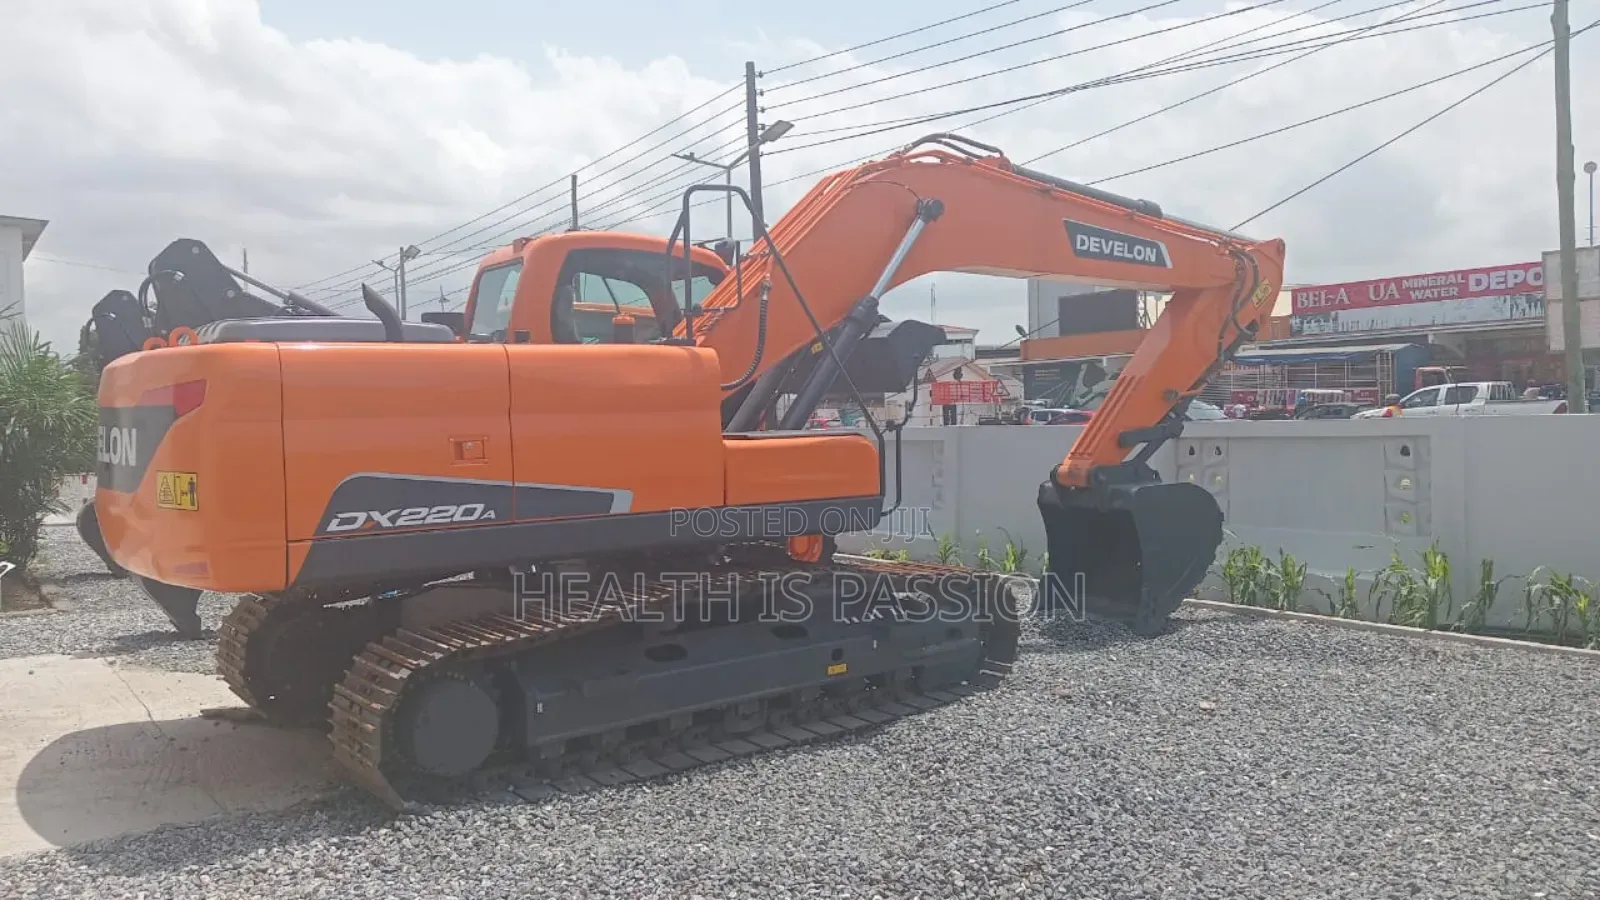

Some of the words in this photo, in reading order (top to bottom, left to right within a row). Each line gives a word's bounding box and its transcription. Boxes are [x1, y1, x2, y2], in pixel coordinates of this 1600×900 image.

[1076, 234, 1157, 262] DEVELON
[1401, 273, 1465, 289] MINERAL
[1410, 287, 1460, 300] WATER
